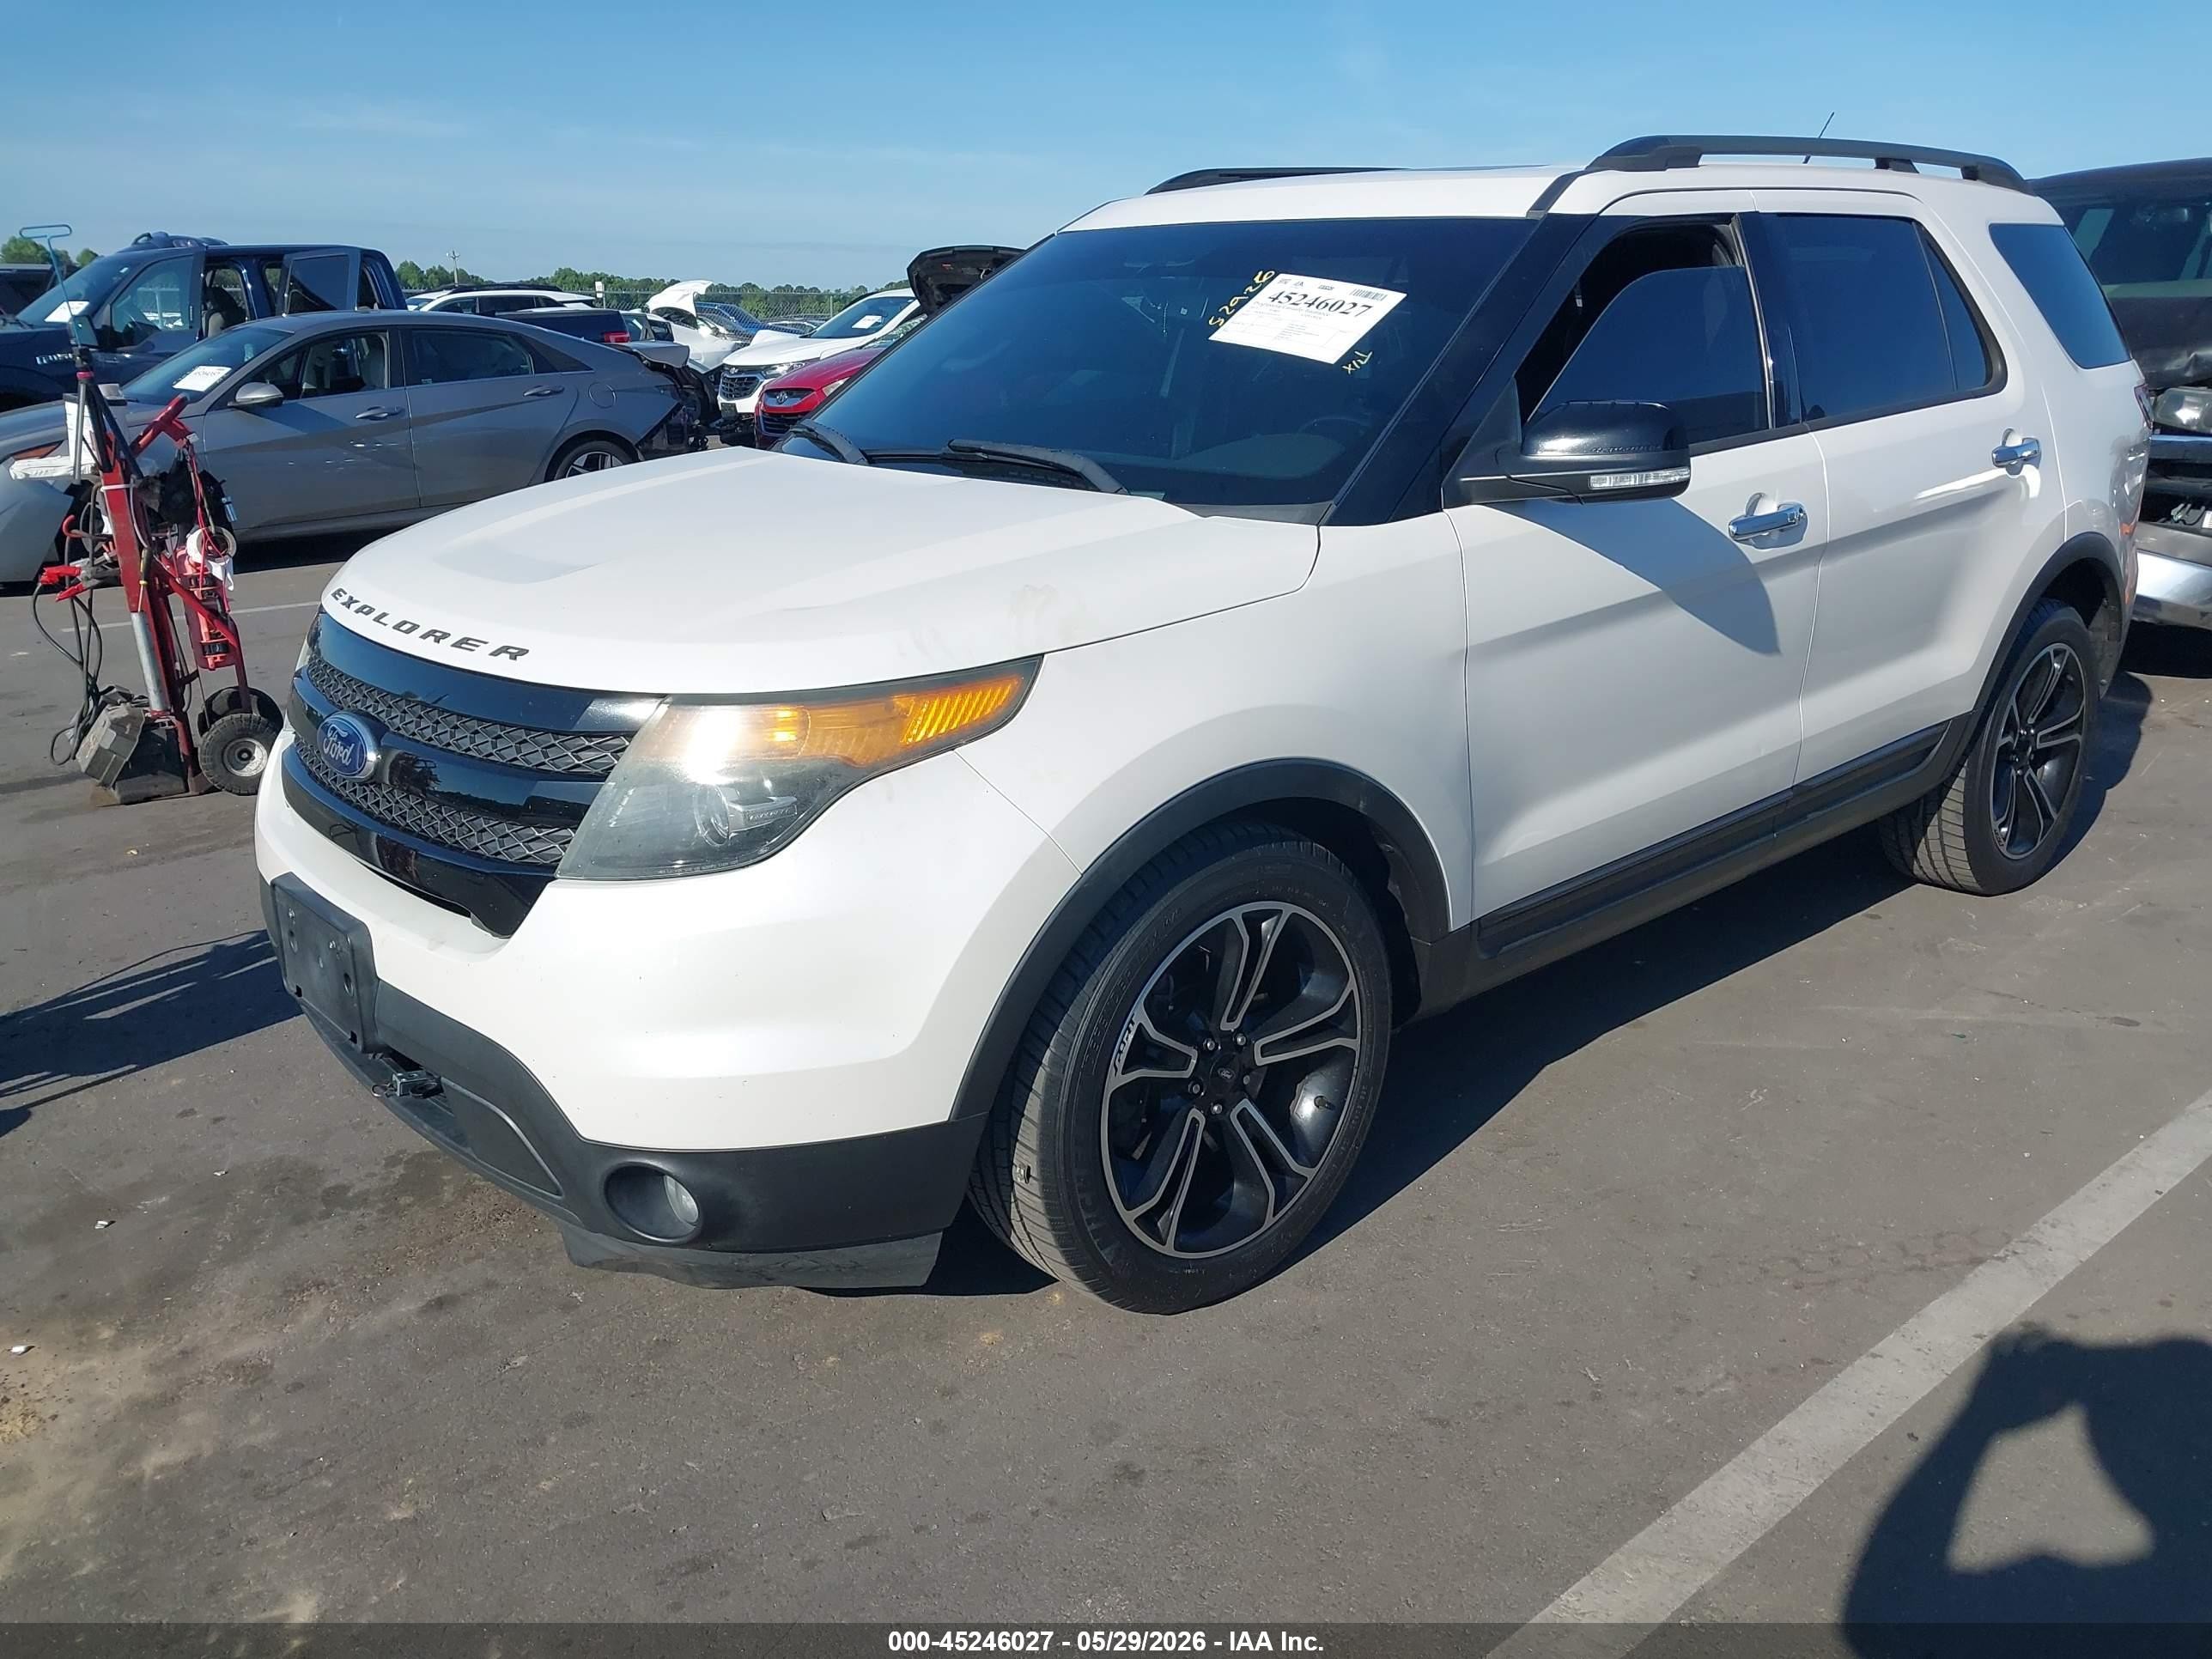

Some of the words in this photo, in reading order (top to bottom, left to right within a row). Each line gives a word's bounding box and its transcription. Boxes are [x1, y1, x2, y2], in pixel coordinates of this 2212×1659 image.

[1267, 290, 1373, 318] 45246027
[330, 586, 530, 661] EXPLORER
[323, 724, 355, 766] Ford
